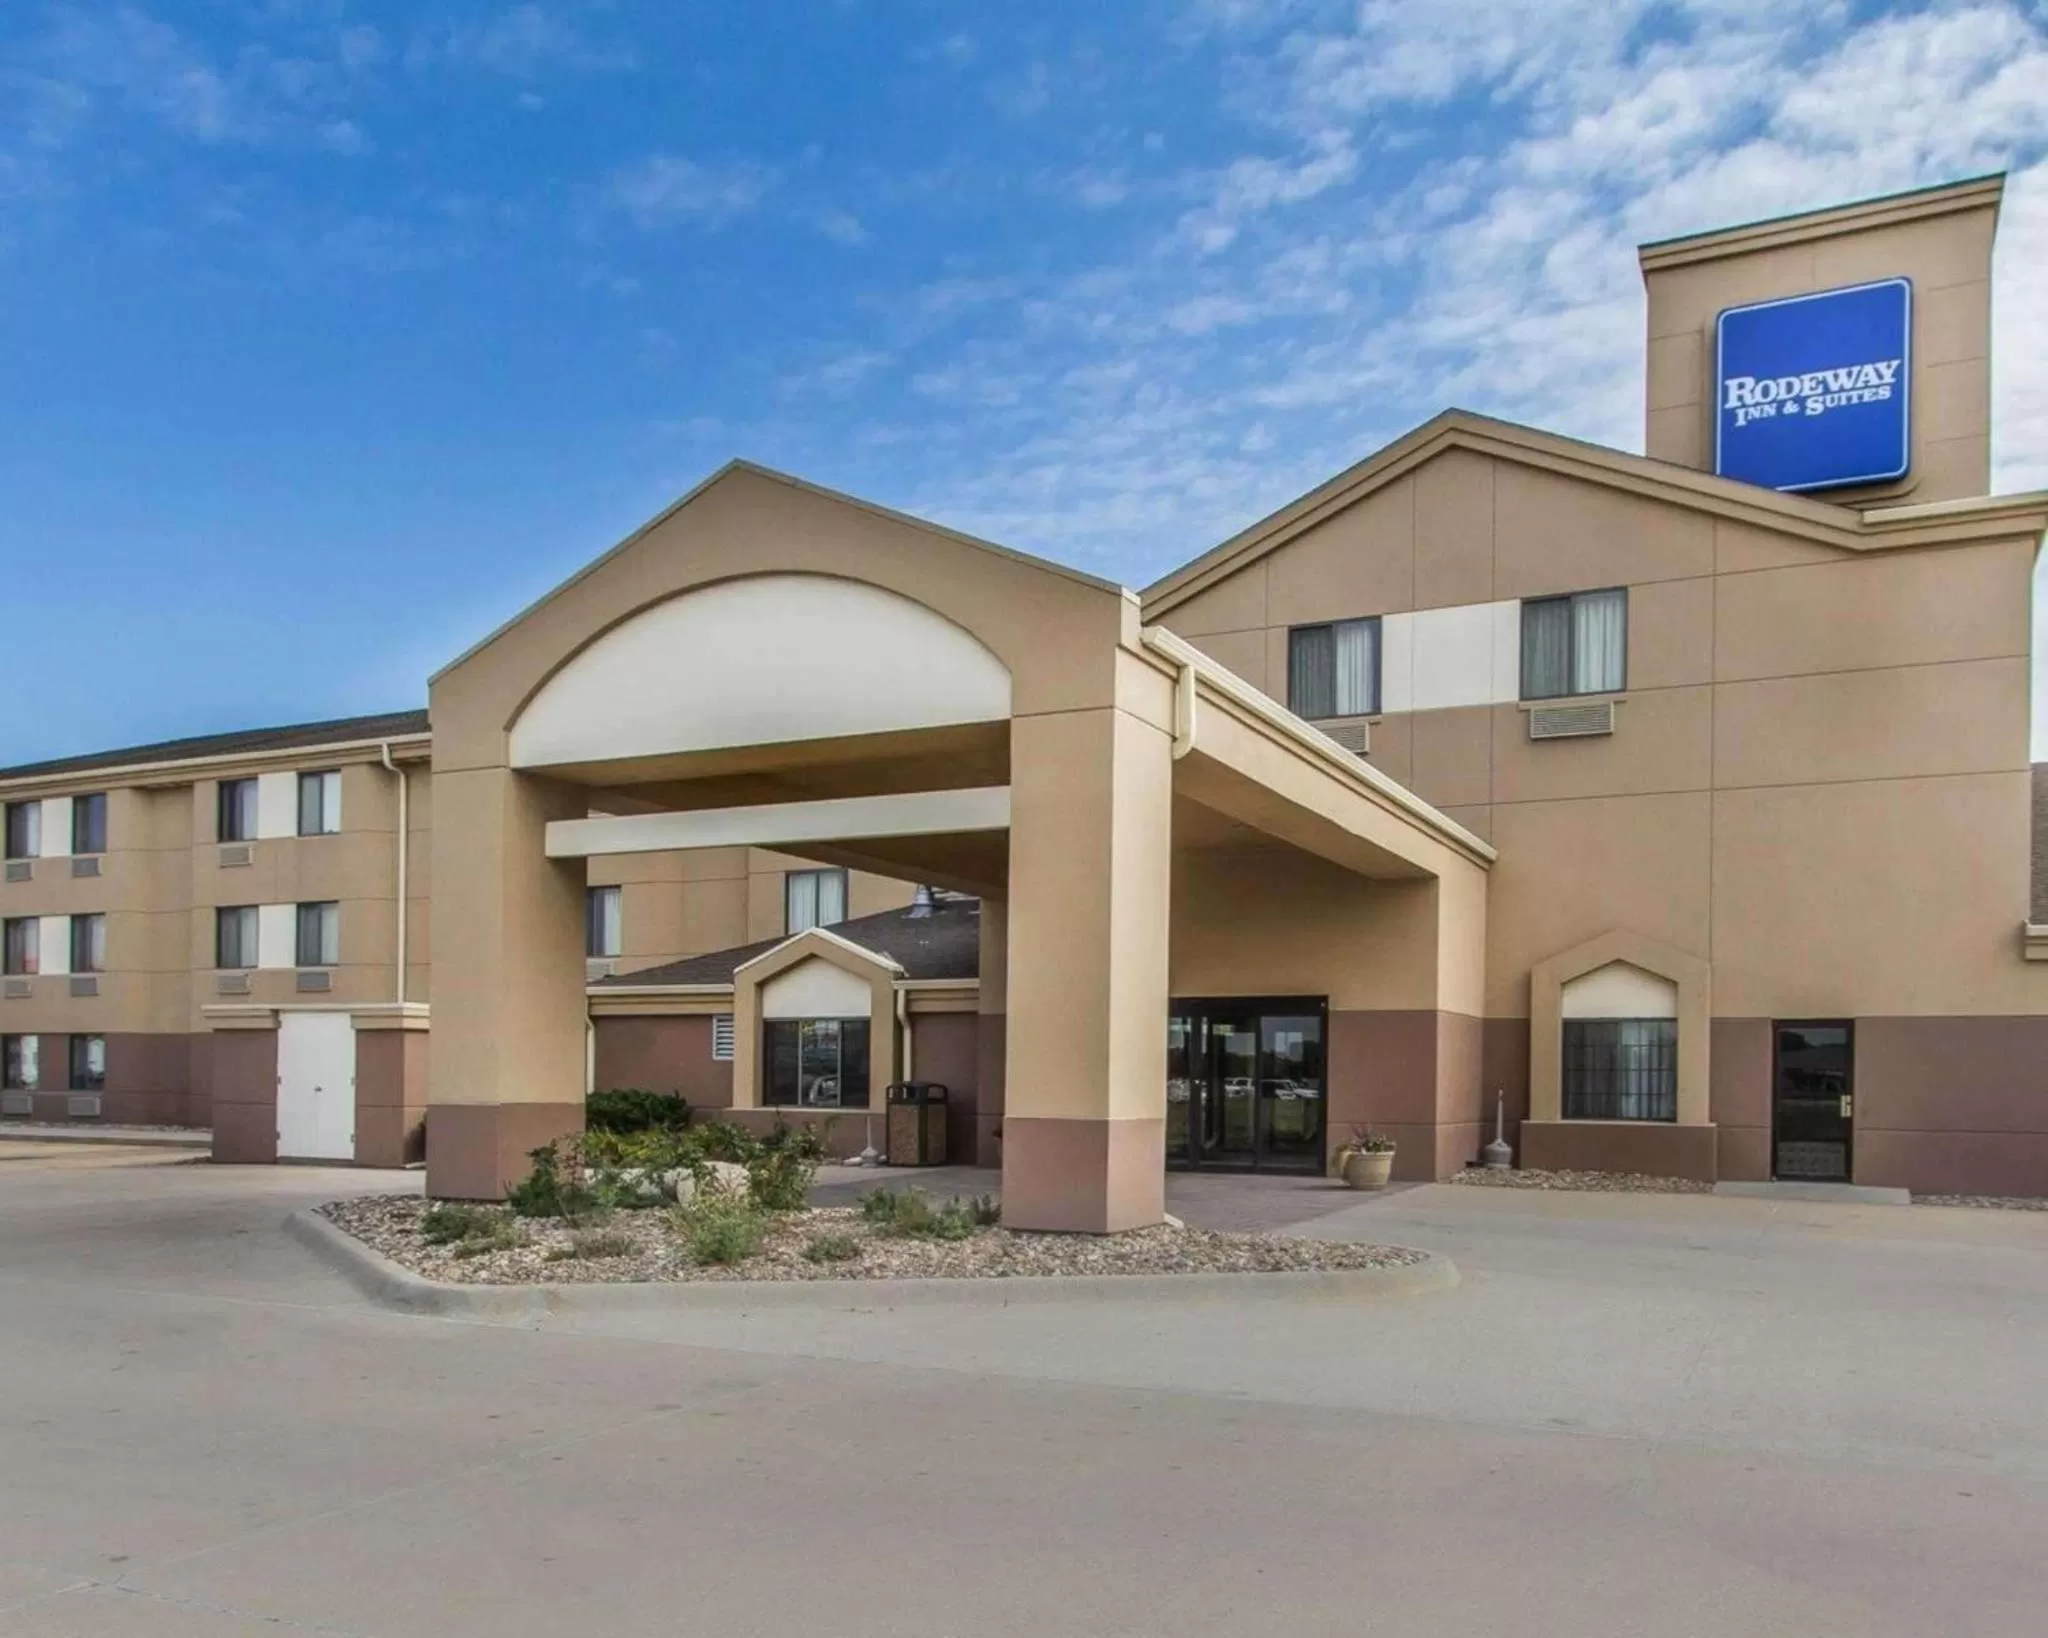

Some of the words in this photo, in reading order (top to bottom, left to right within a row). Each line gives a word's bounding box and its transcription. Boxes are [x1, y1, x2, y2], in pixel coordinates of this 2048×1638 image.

[1724, 359, 1901, 409] RODEWAY
[1735, 403, 1777, 427] INN
[1783, 400, 1799, 414] &
[1805, 385, 1891, 416] SUITES
